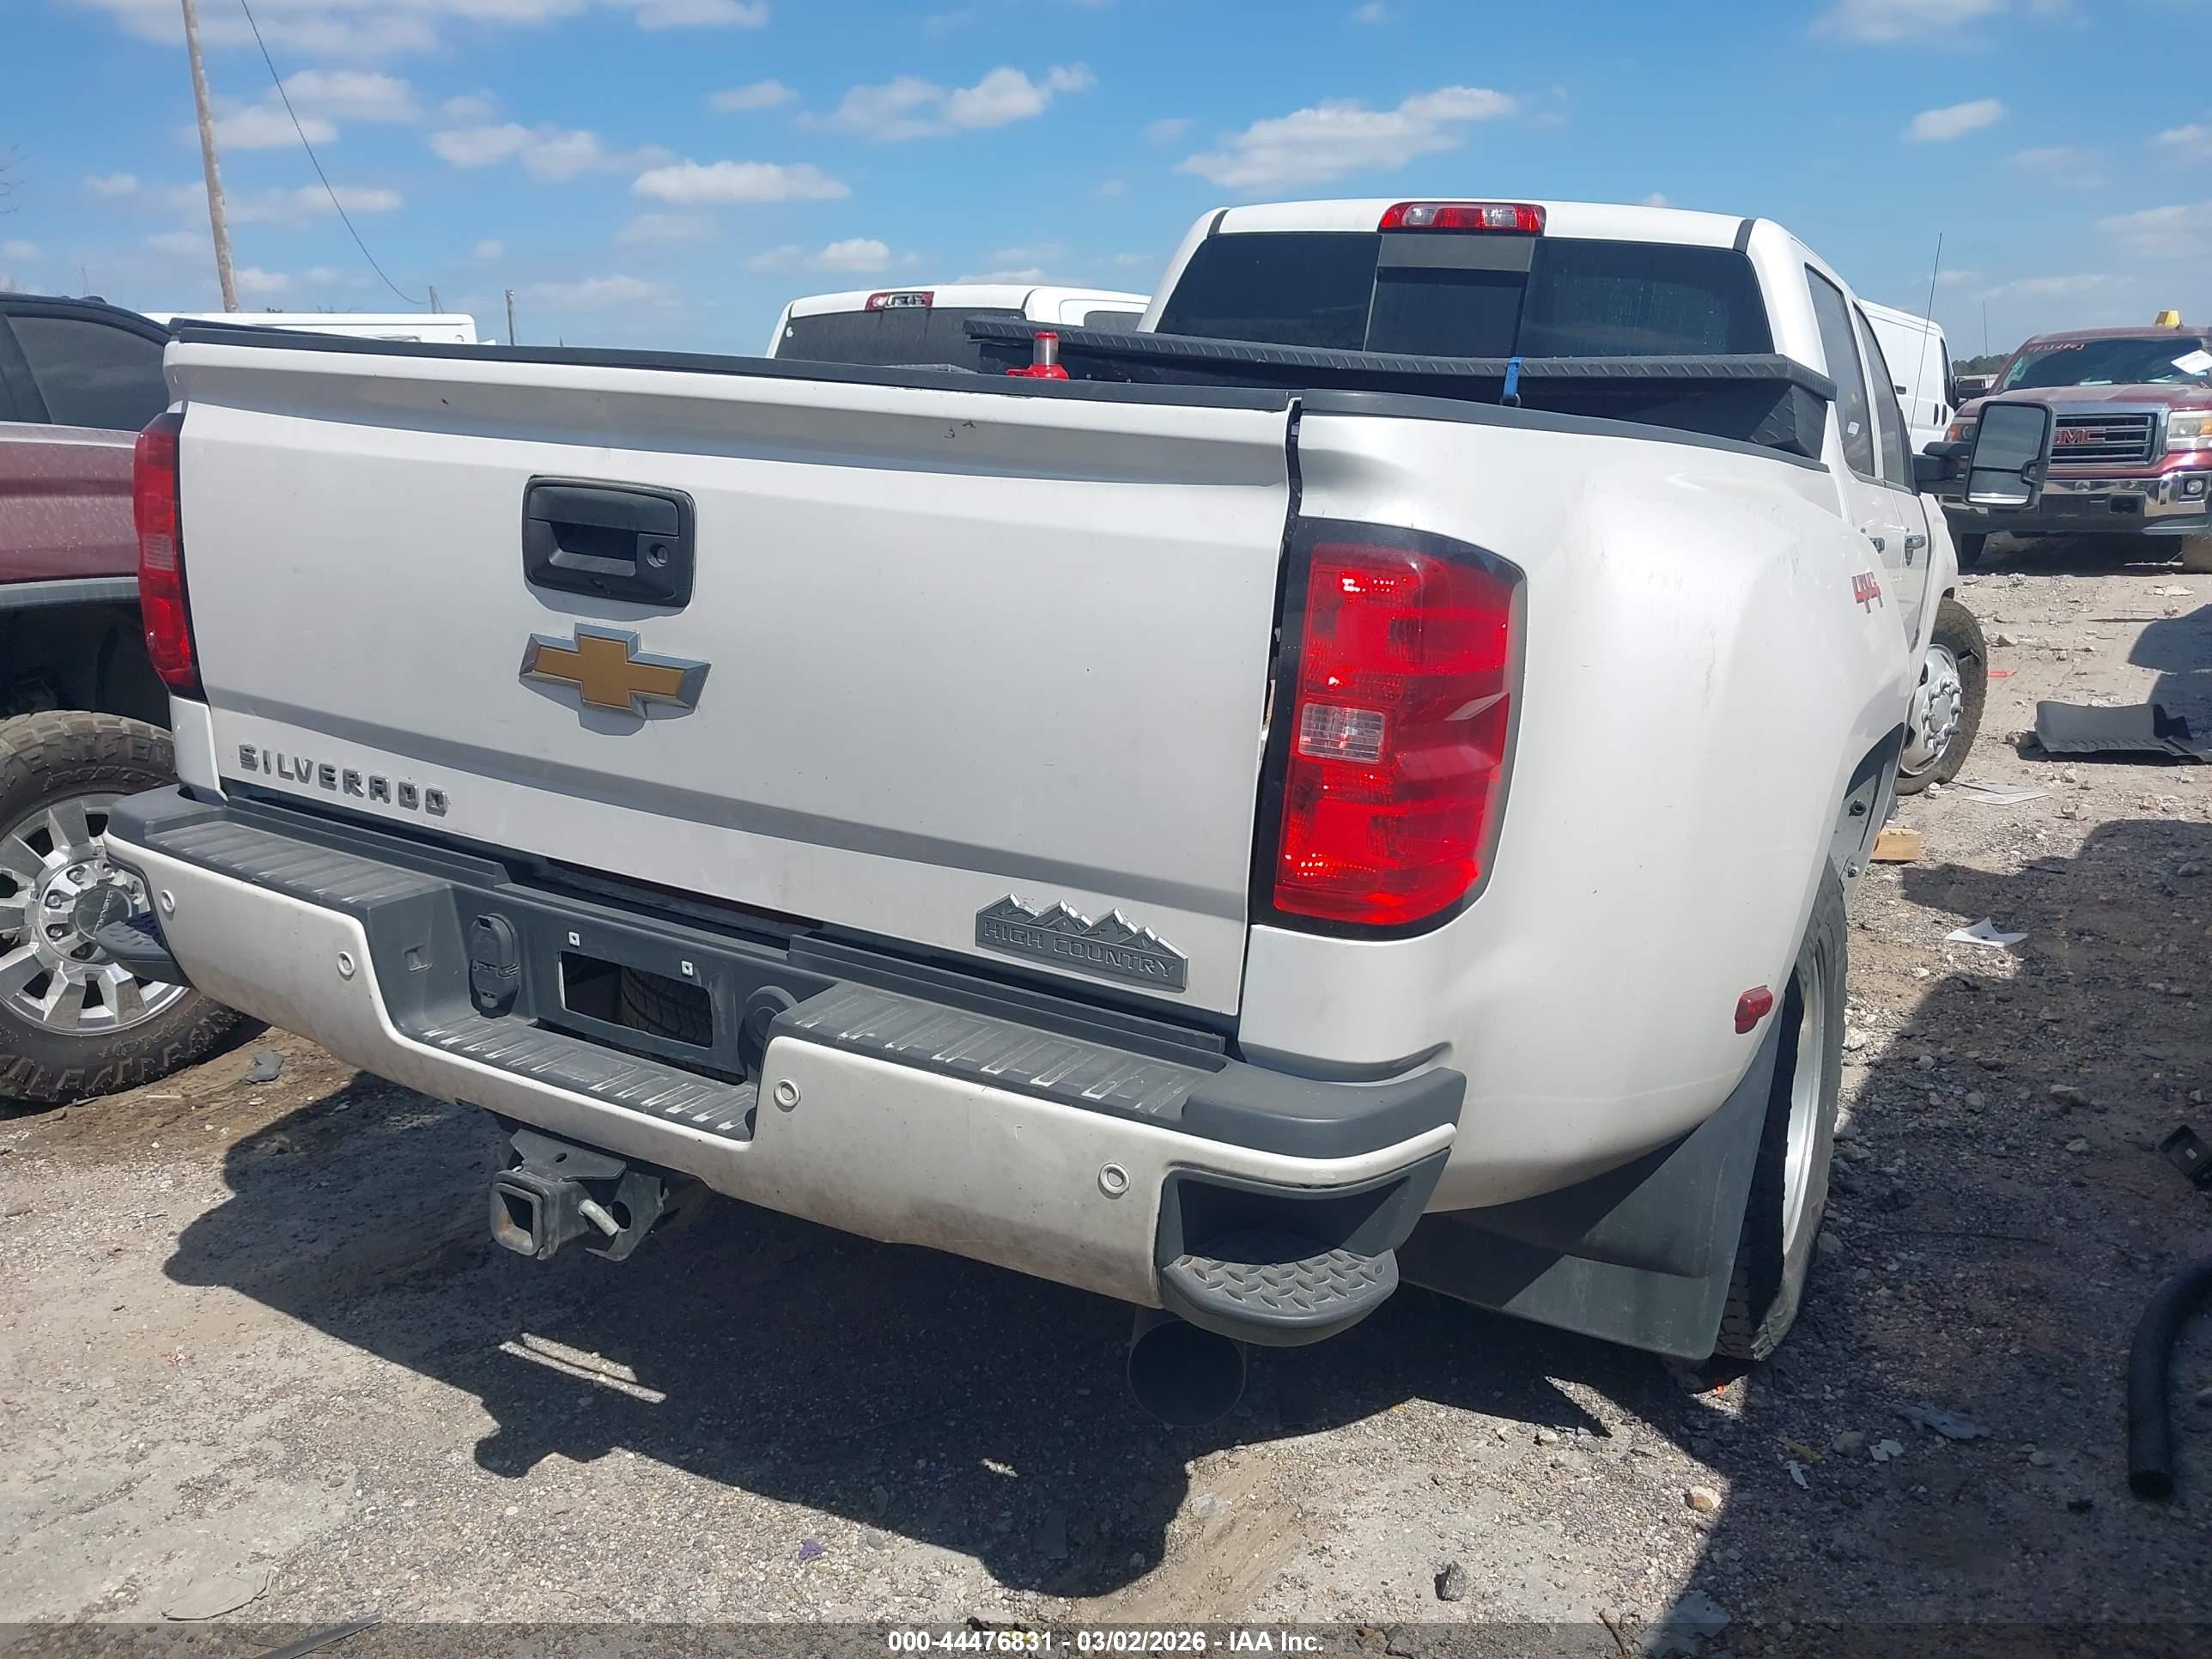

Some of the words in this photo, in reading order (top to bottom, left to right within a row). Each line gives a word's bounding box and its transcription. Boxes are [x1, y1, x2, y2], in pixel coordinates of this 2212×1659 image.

[238, 744, 449, 817] SILVERADO
[984, 922, 1043, 949] HIGH
[1053, 938, 1175, 977] COUNTRY
